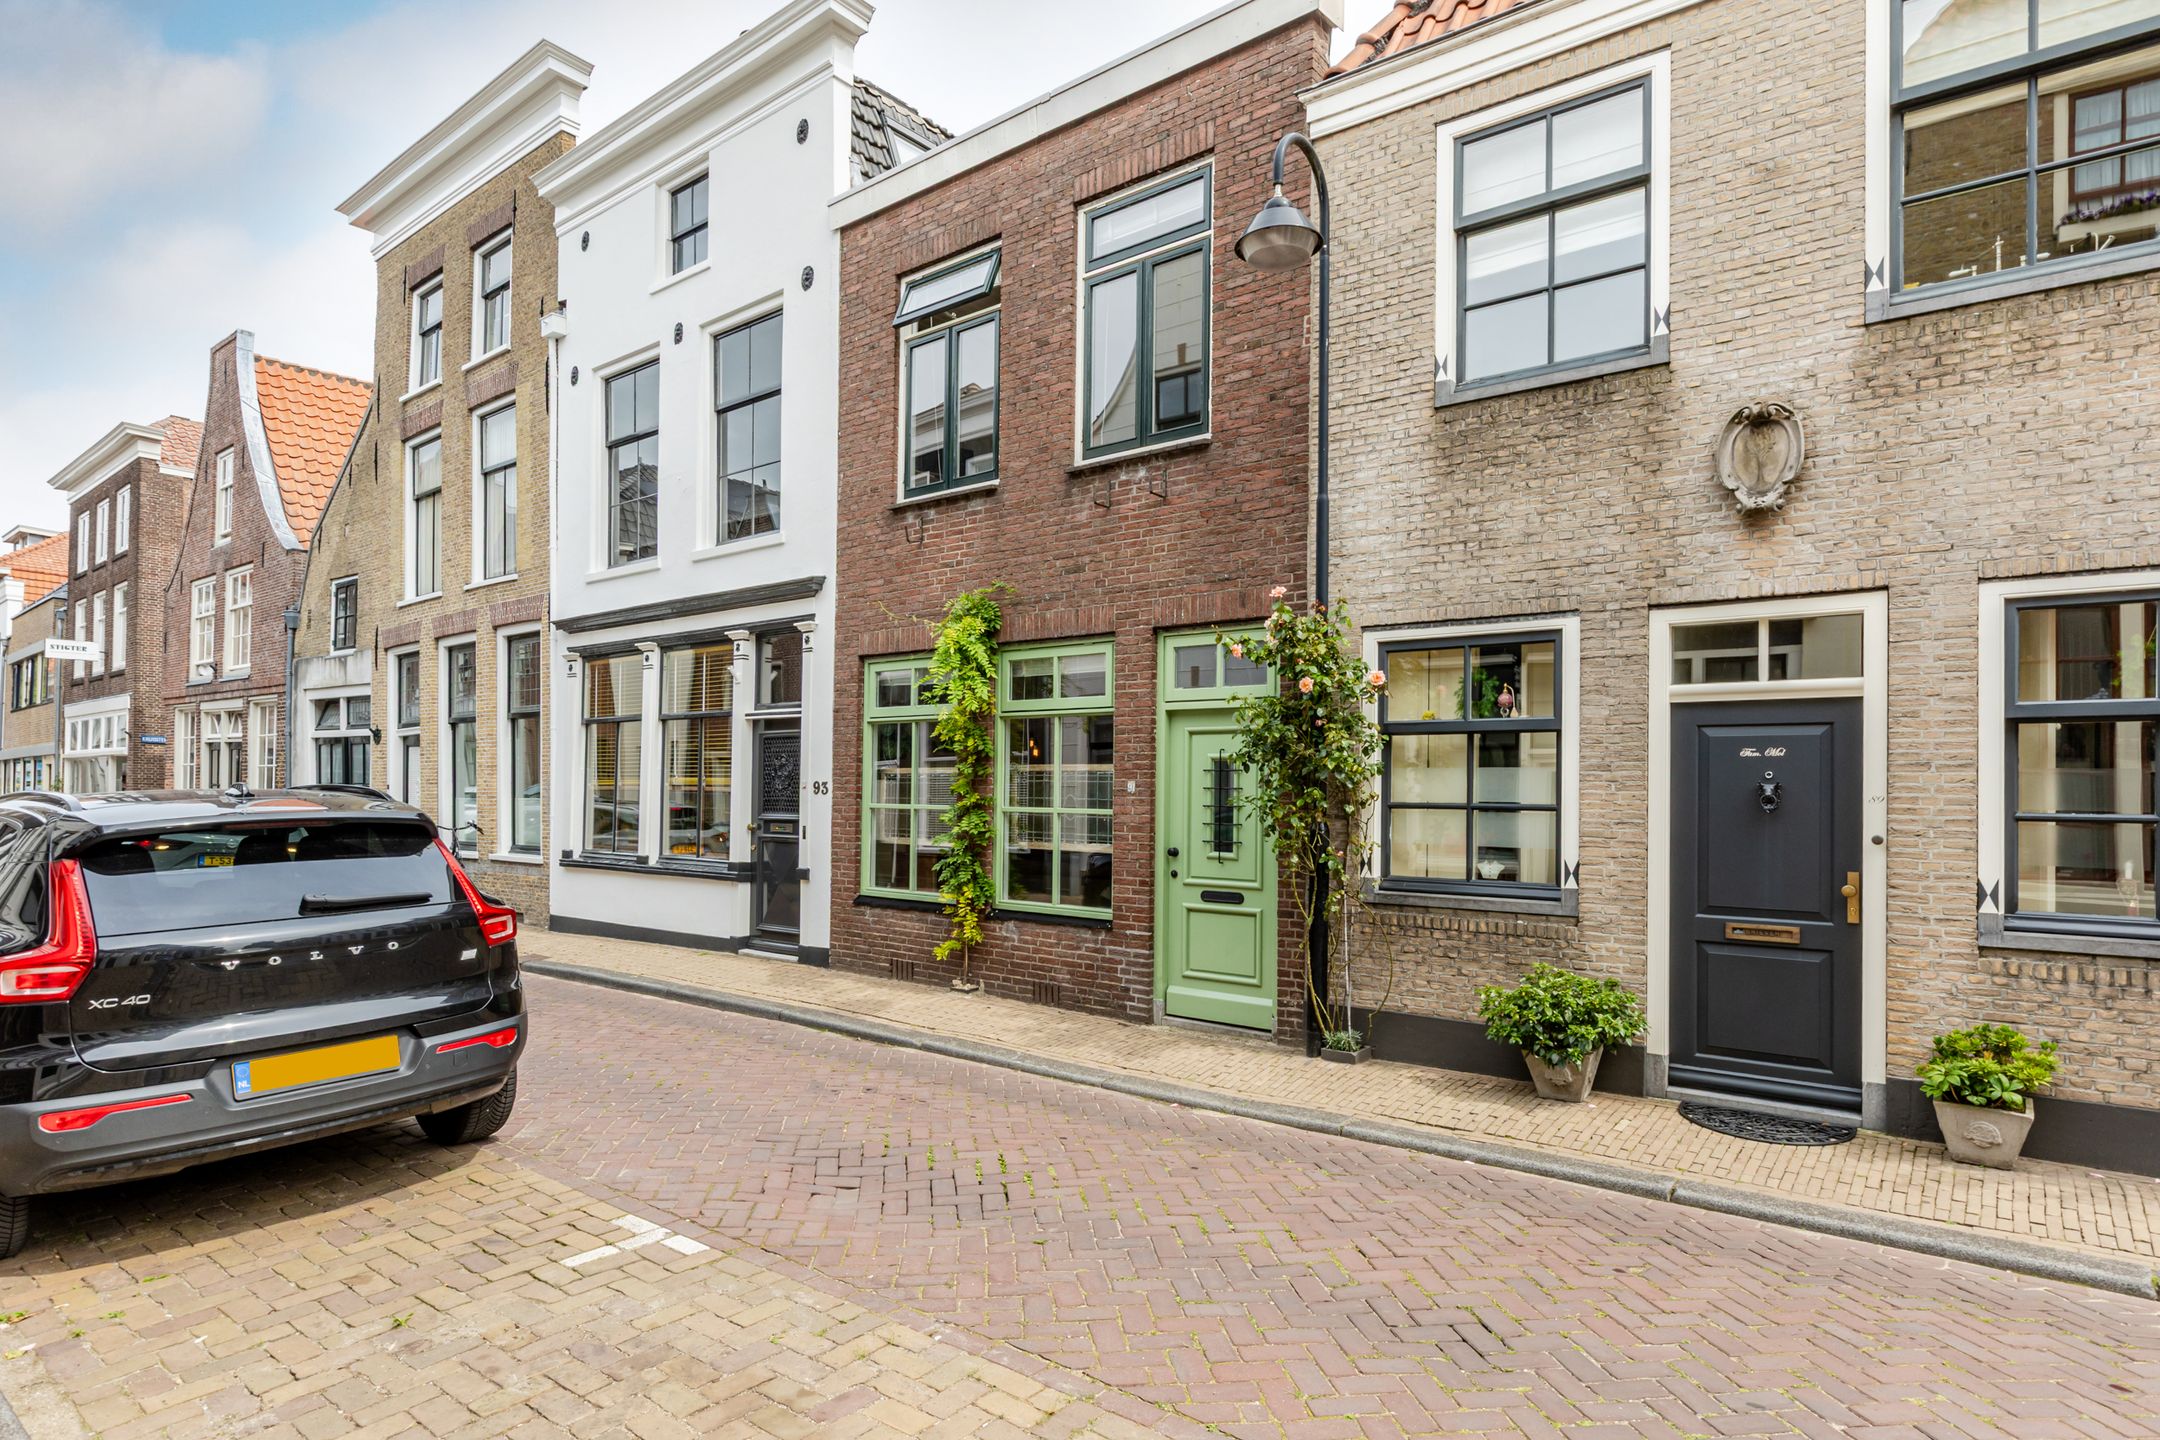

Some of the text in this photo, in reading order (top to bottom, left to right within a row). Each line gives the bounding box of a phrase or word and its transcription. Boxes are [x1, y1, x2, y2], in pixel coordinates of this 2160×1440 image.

[50, 644, 87, 652] STIGTER
[1740, 747, 1762, 757] Fam.
[813, 780, 829, 795] 93
[220, 941, 399, 971] VOLVO
[238, 1080, 251, 1089] NL
